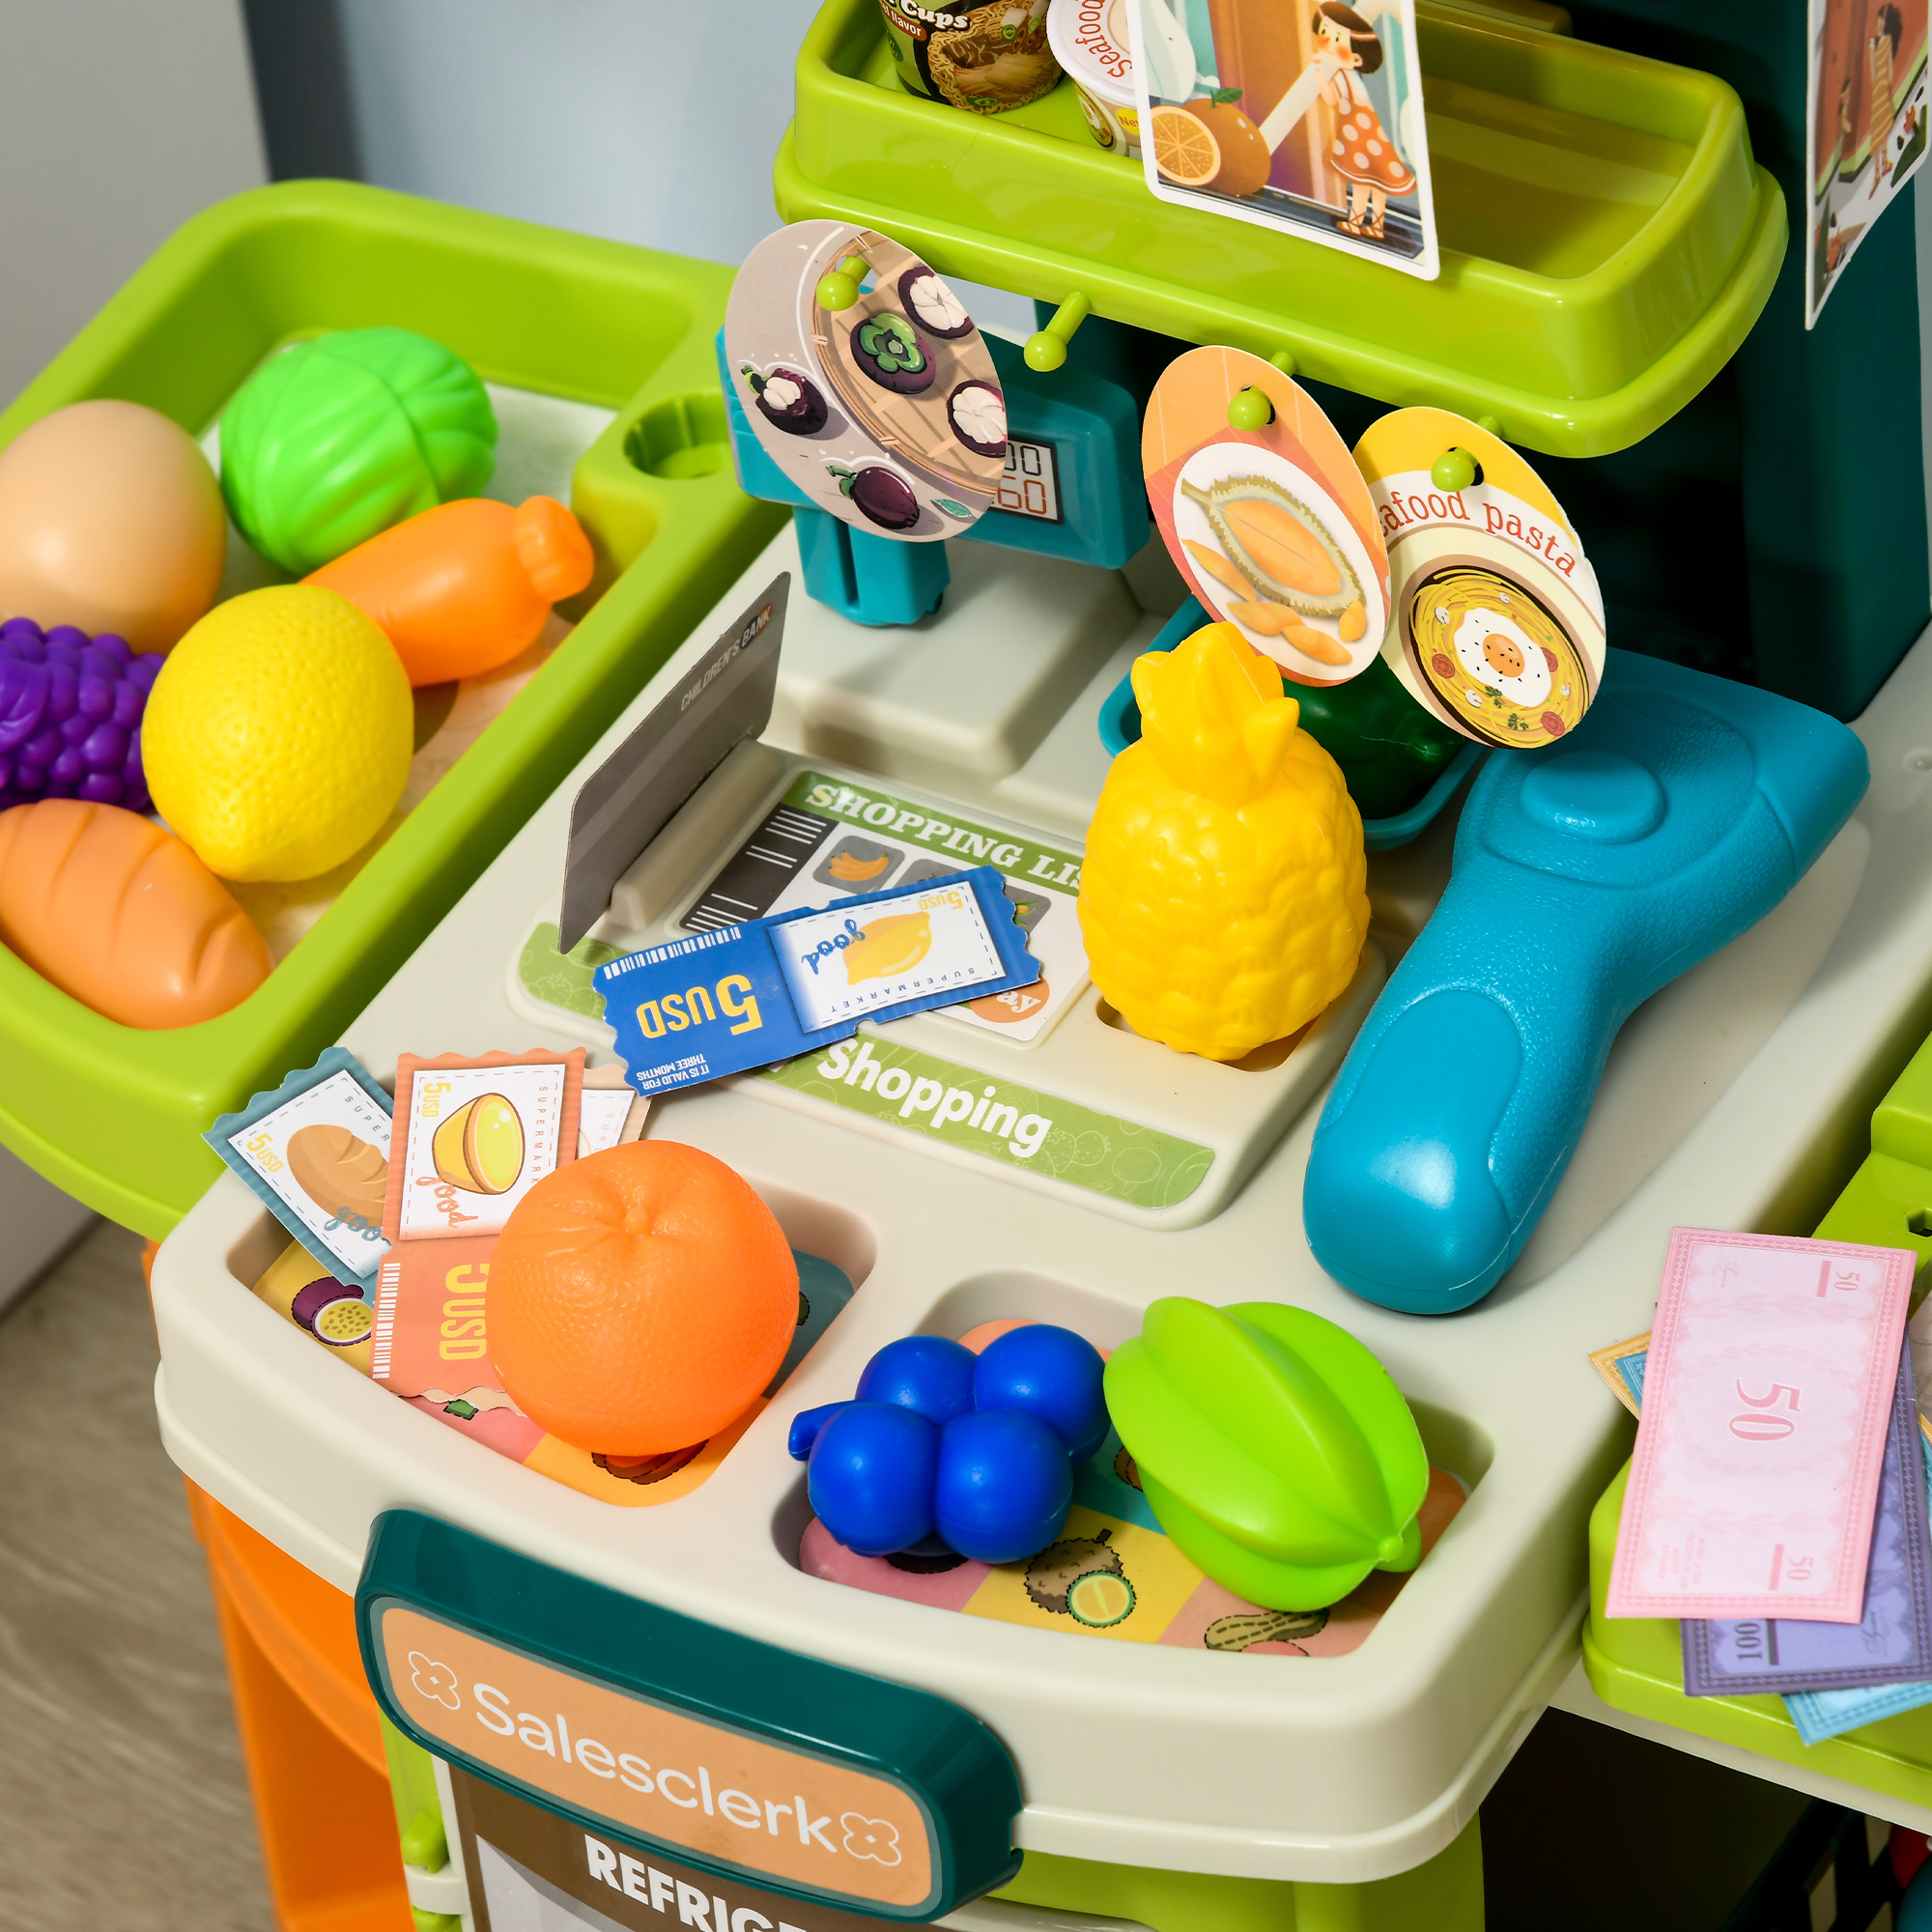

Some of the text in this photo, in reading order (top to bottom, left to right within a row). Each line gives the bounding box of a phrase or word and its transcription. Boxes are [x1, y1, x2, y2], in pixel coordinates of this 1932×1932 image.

[890, 10, 922, 37] flavor
[899, 0, 969, 30] Cups
[1119, 115, 1139, 128] Ne
[1482, 502, 1576, 578] pasta
[680, 639, 741, 712] CHILDREN'S
[741, 604, 772, 648] BANK
[805, 783, 1025, 868] SHOPPING
[831, 966, 976, 1013] SUPERMARKET
[636, 1053, 707, 1081] THREE MONTHS
[641, 1064, 710, 1091] IT IS VALID FOR
[816, 1037, 1053, 1158] Shopping
[324, 1206, 392, 1247] goo
[1833, 1269, 1861, 1292] 50
[1729, 1378, 1802, 1442] 50
[1786, 1555, 1814, 1581] 50
[1734, 1622, 1763, 1661] 100
[471, 1682, 838, 1854] Salesclerk
[583, 1833, 809, 1932] REFRIG
